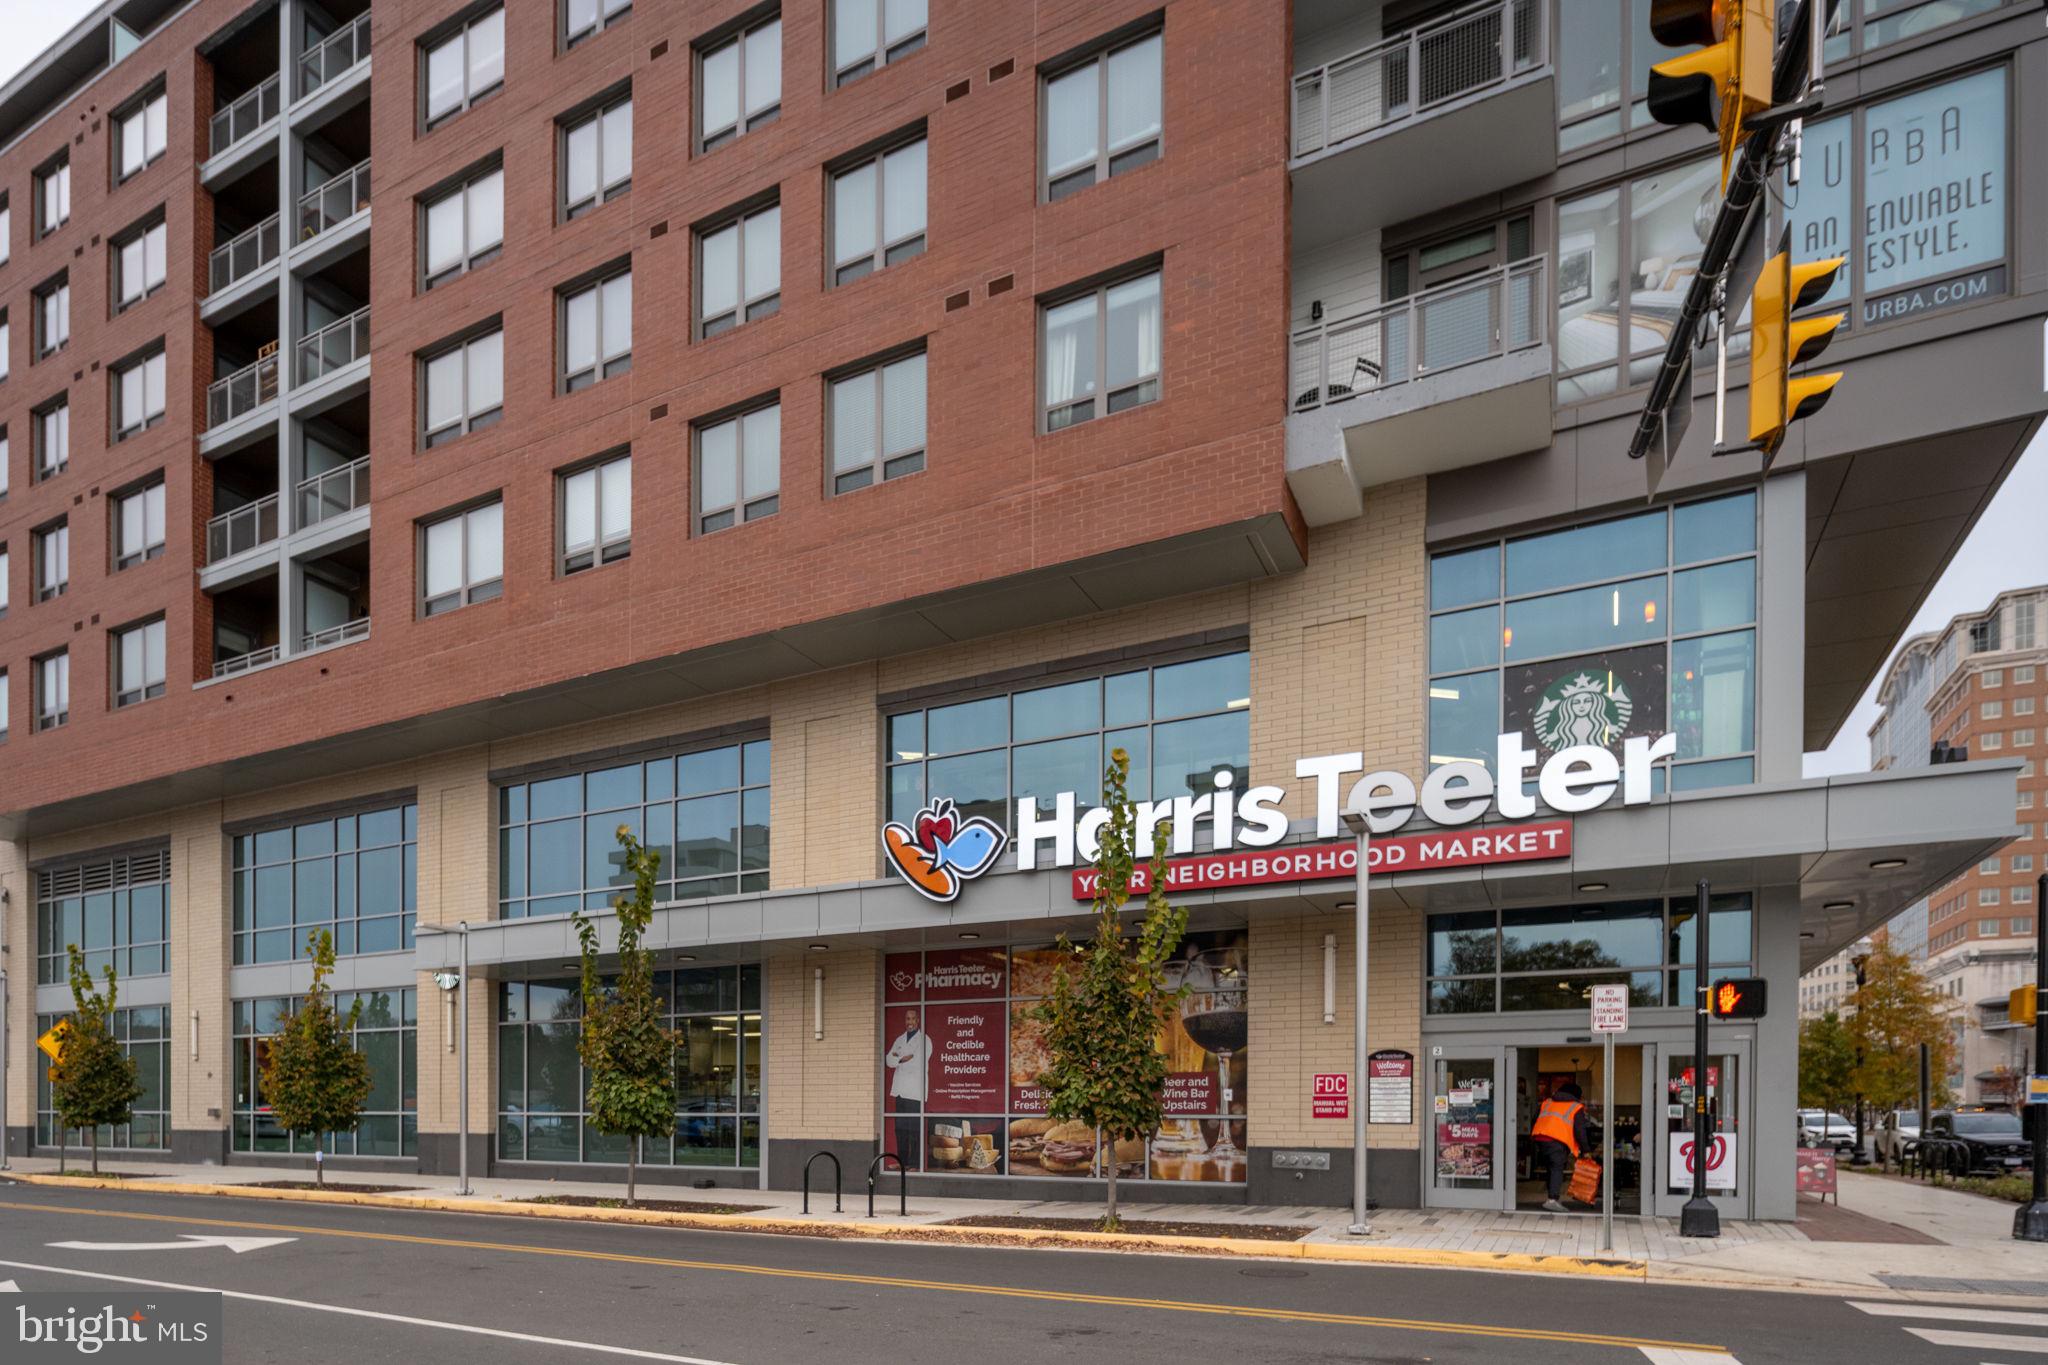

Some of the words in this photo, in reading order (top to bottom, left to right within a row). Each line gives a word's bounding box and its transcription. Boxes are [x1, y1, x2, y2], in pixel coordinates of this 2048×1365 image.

[1825, 106, 1960, 188] URBA
[1865, 171, 1993, 236] ENVIABLE
[1017, 770, 1290, 871] Harris
[1296, 732, 1676, 838] Teeter
[1419, 828, 1564, 861] MARKET
[933, 966, 958, 974] Harris
[959, 964, 986, 973] Teeter
[914, 971, 1002, 989] Pharmacy
[947, 1015, 984, 1026] Friendly
[1594, 1015, 1606, 1023] FIRE
[1609, 1015, 1625, 1023] LANE
[956, 1028, 974, 1037] and
[946, 1040, 985, 1050] Credible
[940, 1053, 991, 1062] Healthcare
[944, 1065, 987, 1075] Providers
[1376, 1061, 1405, 1070] Welcome
[1188, 1076, 1208, 1086] and
[1316, 1076, 1345, 1092] FDC
[1190, 1088, 1209, 1098] Bar
